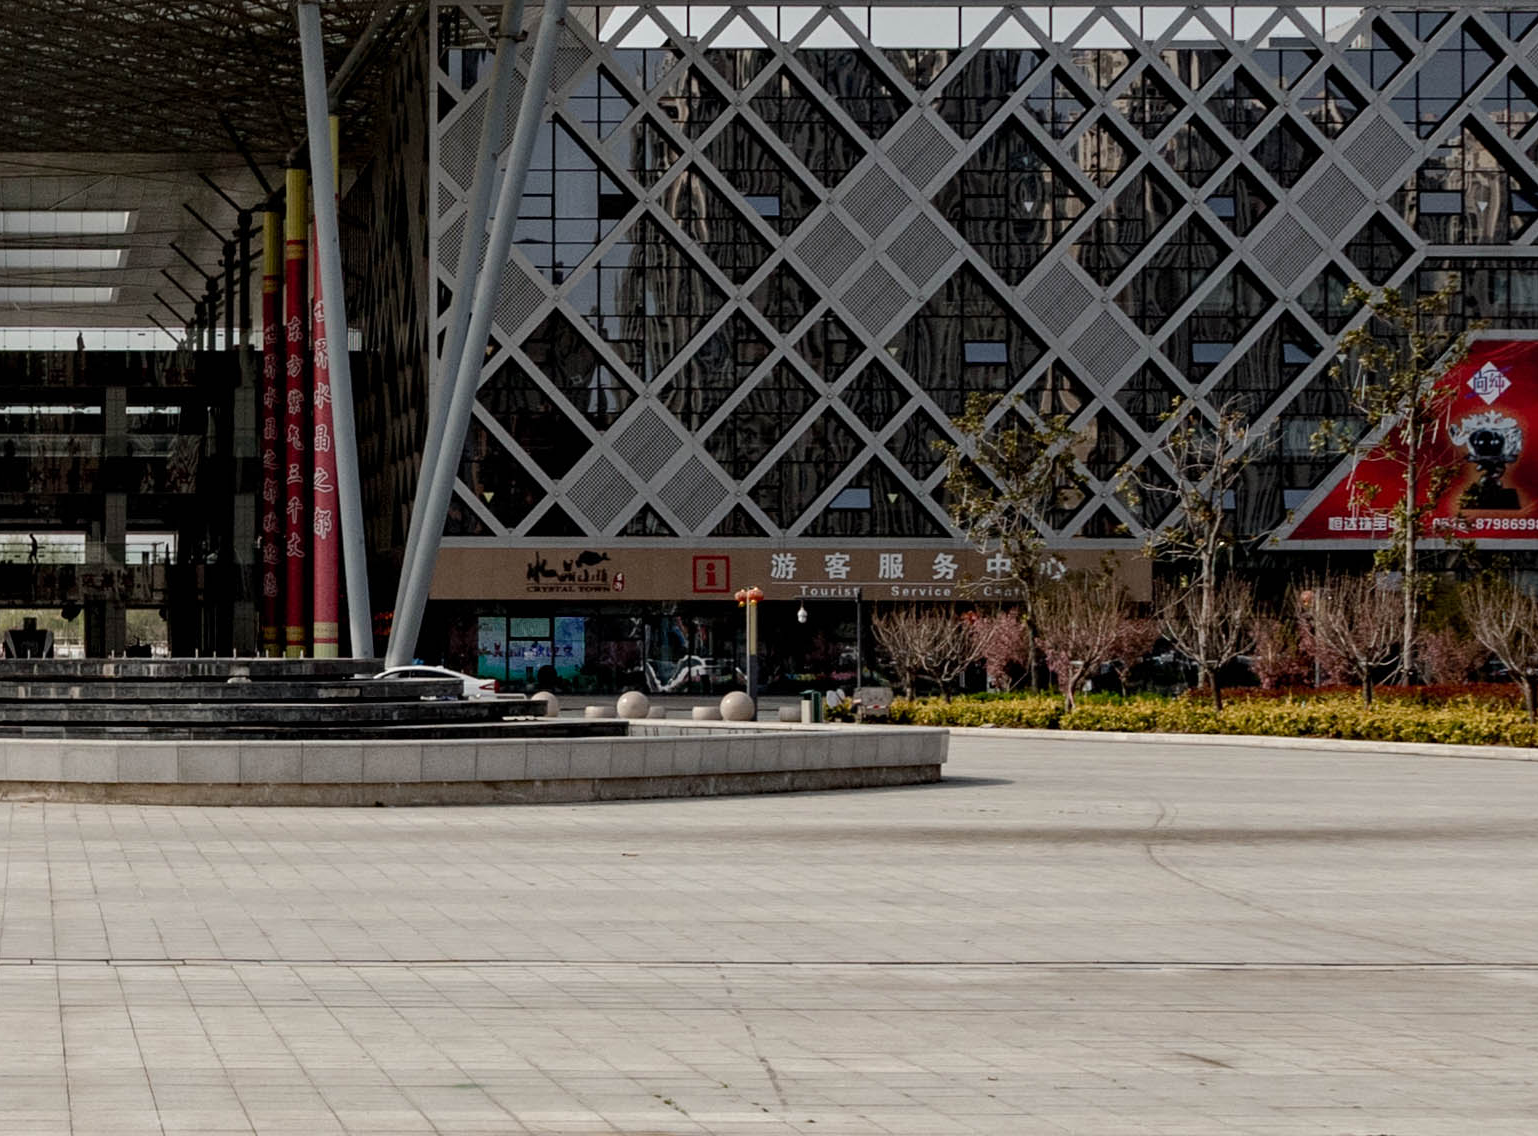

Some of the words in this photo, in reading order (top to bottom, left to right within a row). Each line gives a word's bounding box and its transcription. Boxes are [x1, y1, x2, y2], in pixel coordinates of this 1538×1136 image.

[770, 552, 1066, 581] 游客服务中心
[800, 585, 861, 598] Tourist
[890, 585, 952, 598] Service
